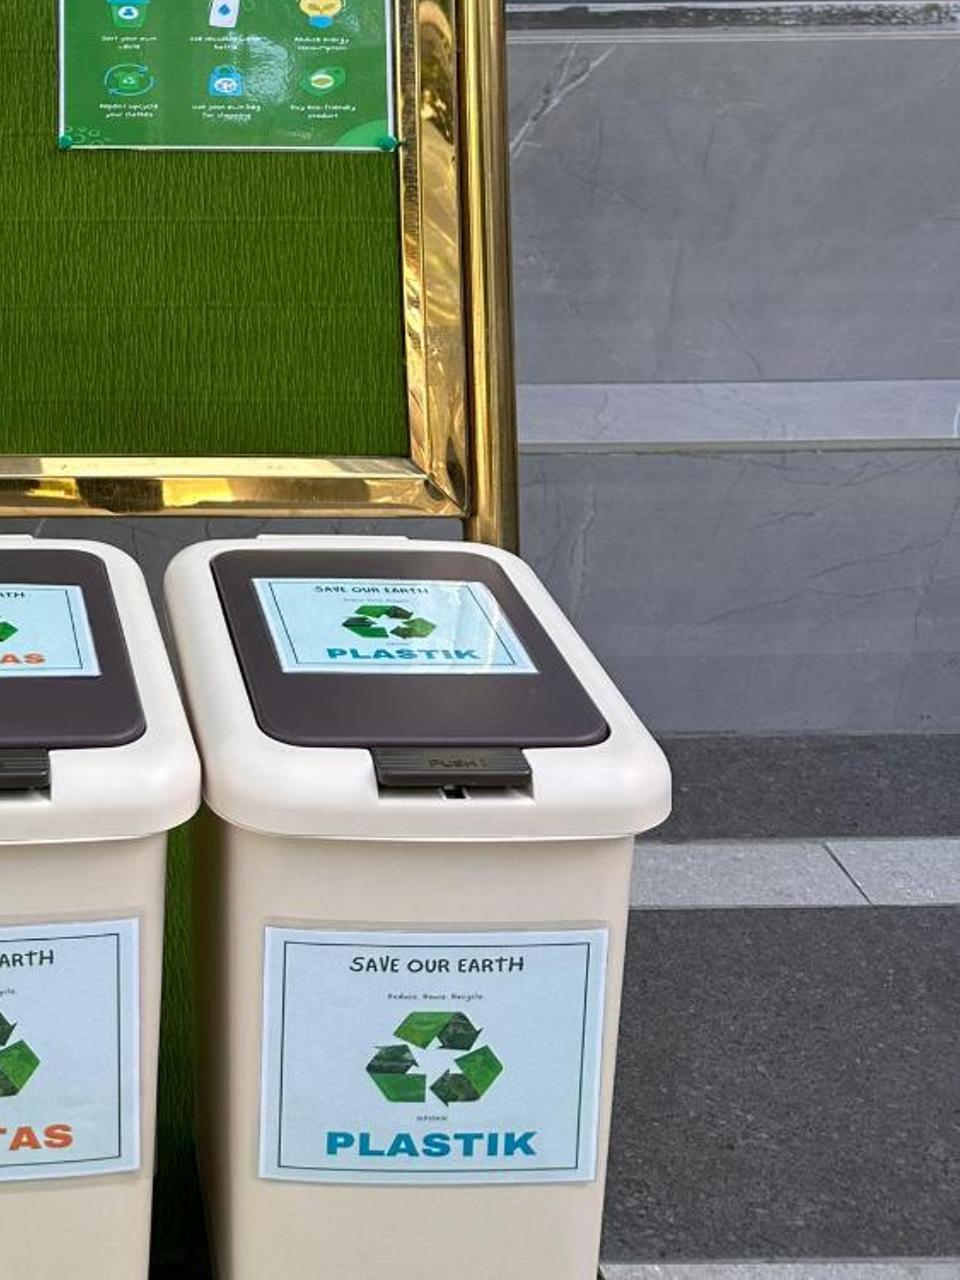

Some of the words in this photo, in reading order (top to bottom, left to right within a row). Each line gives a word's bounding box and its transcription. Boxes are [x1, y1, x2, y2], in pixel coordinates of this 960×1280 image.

[313, 585, 347, 594] SAVE
[351, 585, 381, 594] OUR
[384, 586, 430, 595] EARTH
[326, 647, 482, 661] PLASTIK
[348, 955, 400, 973] SAVE
[406, 957, 450, 973] OUR
[457, 955, 525, 973] EARTH
[325, 1130, 538, 1158] PLASTIK
